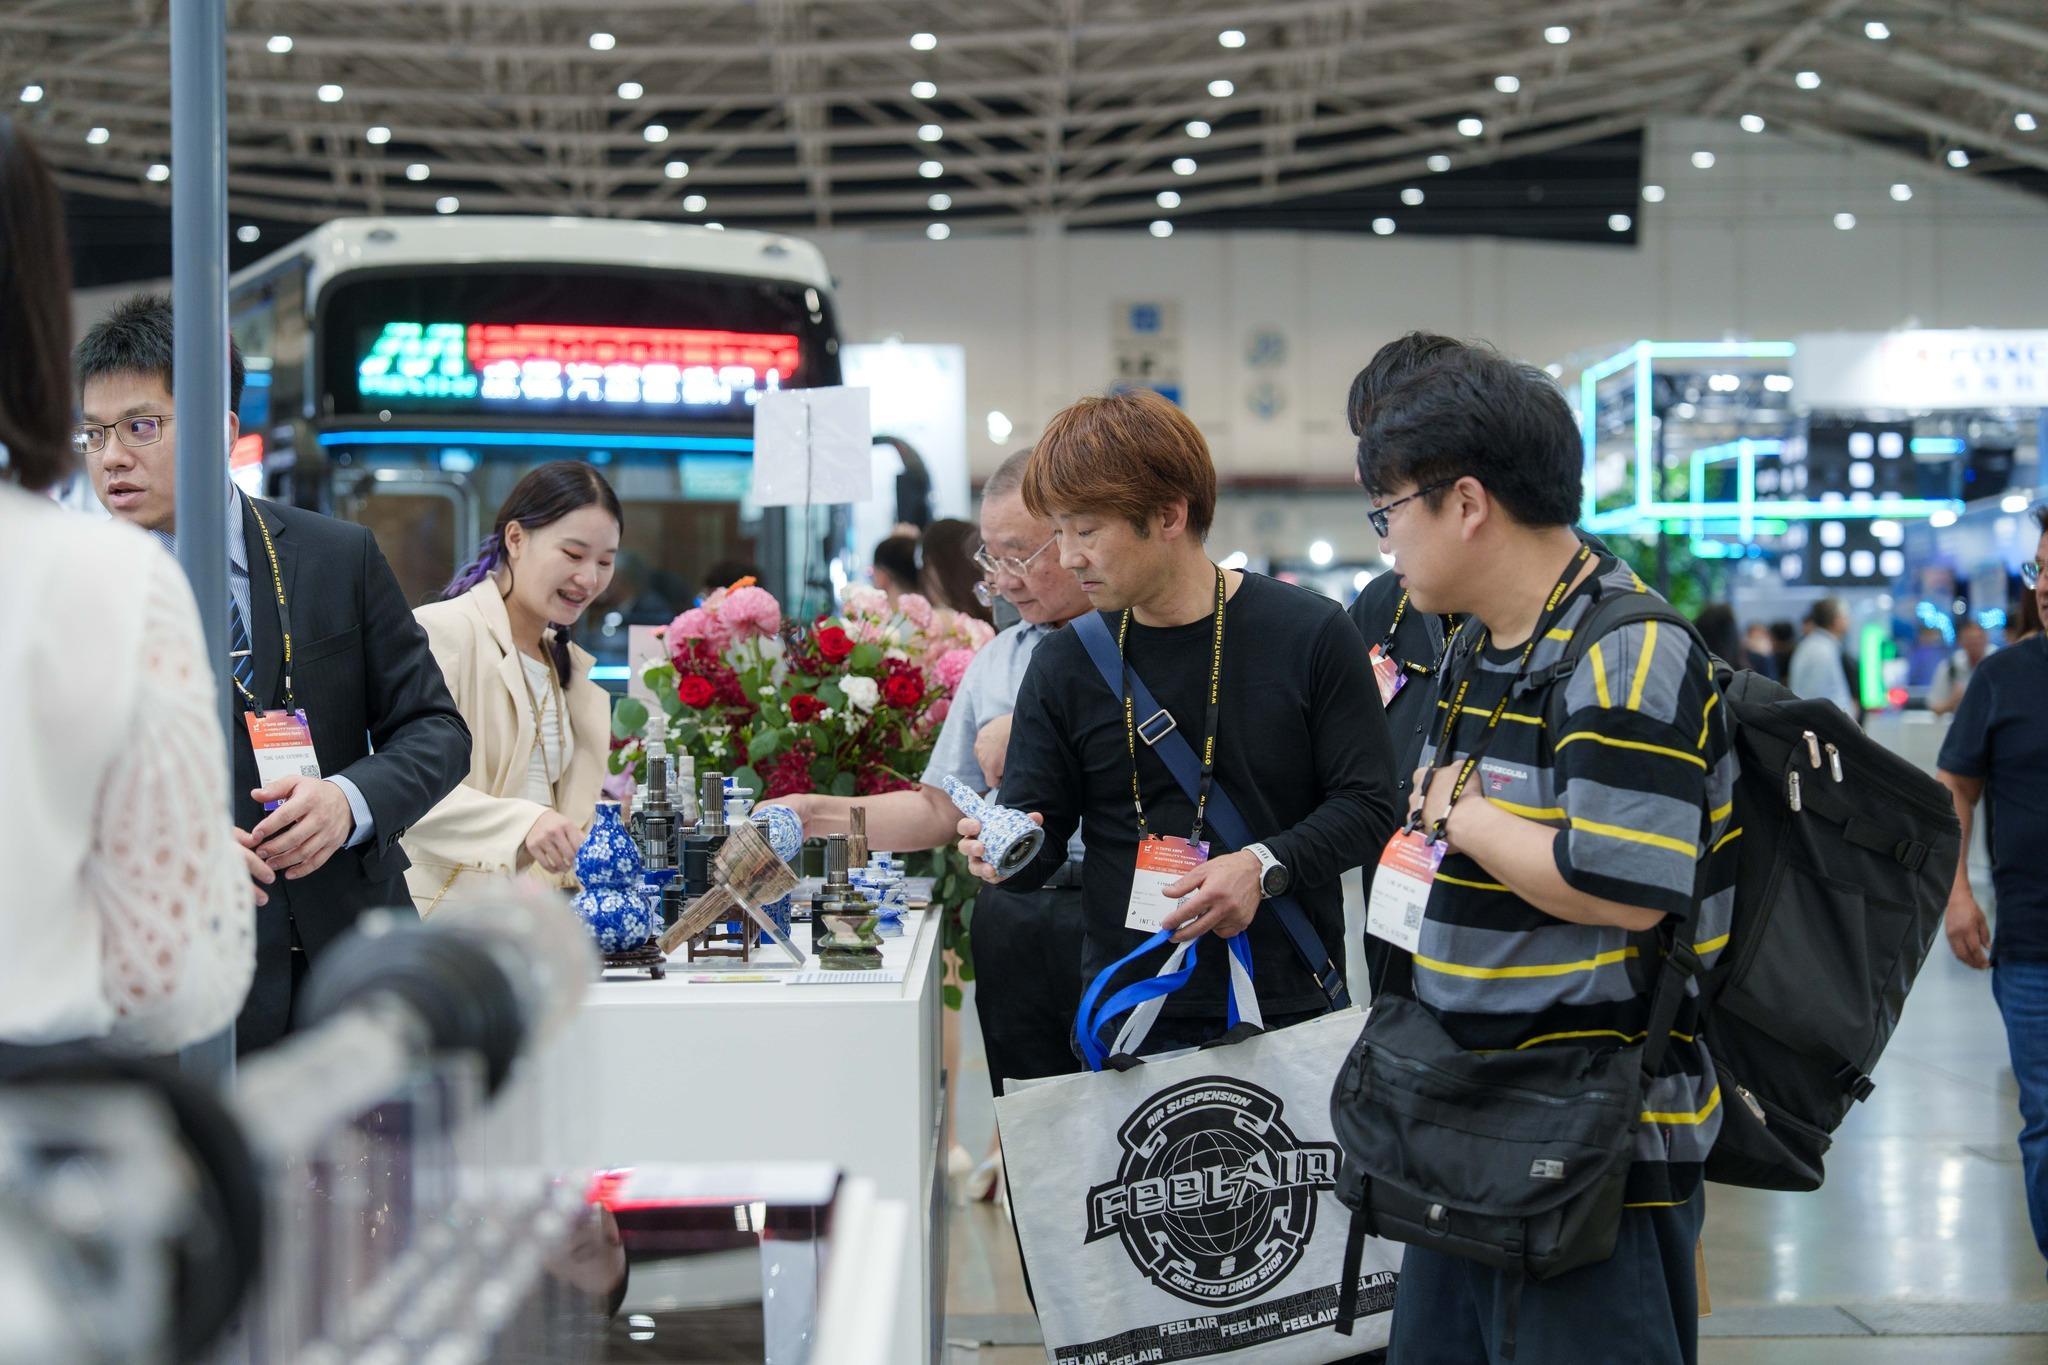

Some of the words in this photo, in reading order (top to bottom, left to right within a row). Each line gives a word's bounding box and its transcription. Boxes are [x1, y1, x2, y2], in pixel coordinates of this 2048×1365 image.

[1146, 1108, 1165, 1129] AIR
[1166, 1090, 1252, 1114] SUSPENSION
[1170, 1273, 1195, 1290] ONE
[1194, 1283, 1227, 1295] STOP
[1227, 1273, 1258, 1294] DROP
[1258, 1251, 1283, 1280] SHOP
[1159, 1316, 1218, 1337] FEELAIR
[1335, 1272, 1395, 1297] FELAIR
[1220, 1312, 1280, 1337] FEELAIR
